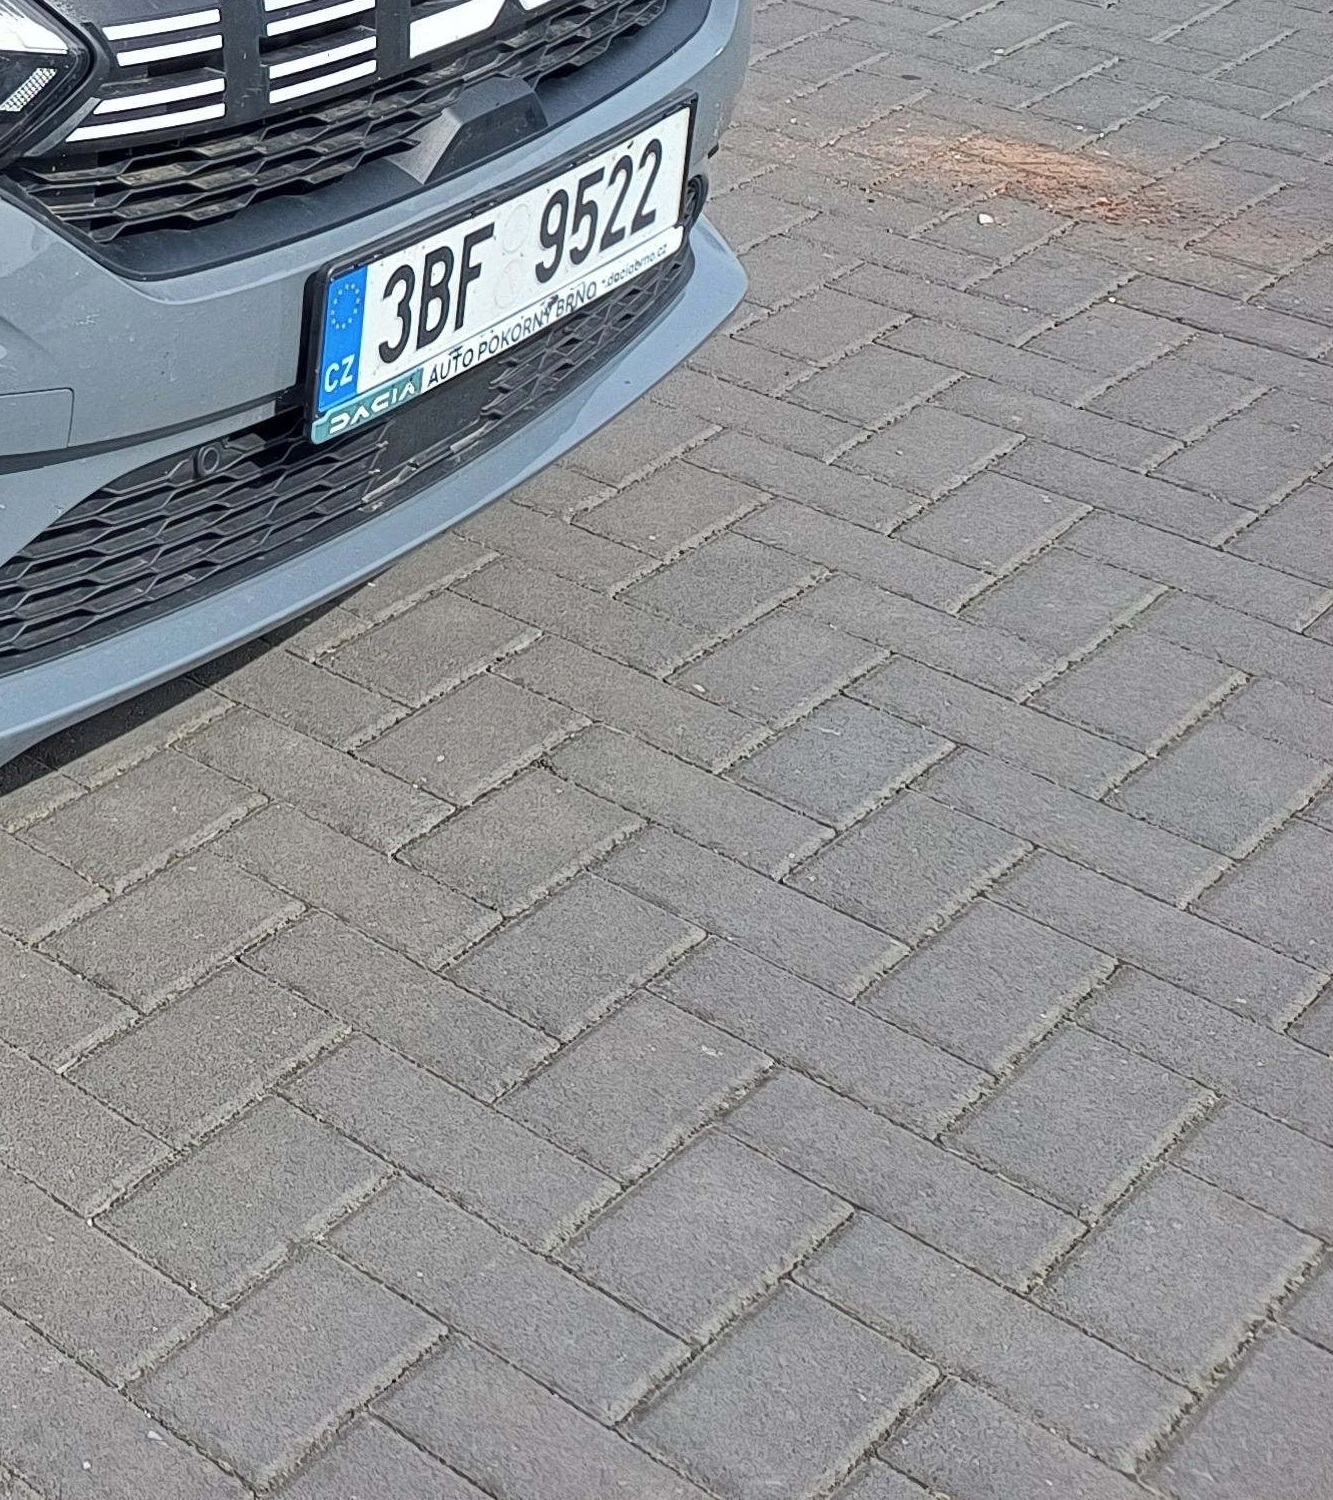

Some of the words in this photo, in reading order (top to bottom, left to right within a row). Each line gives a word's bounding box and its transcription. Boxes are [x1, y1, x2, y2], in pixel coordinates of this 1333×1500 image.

[378, 222, 496, 365] 3BF
[534, 137, 663, 285] 9522
[324, 353, 355, 393] CZ
[329, 380, 416, 434] DACIA
[428, 348, 474, 387] AUTO
[555, 281, 598, 318] BRNO
